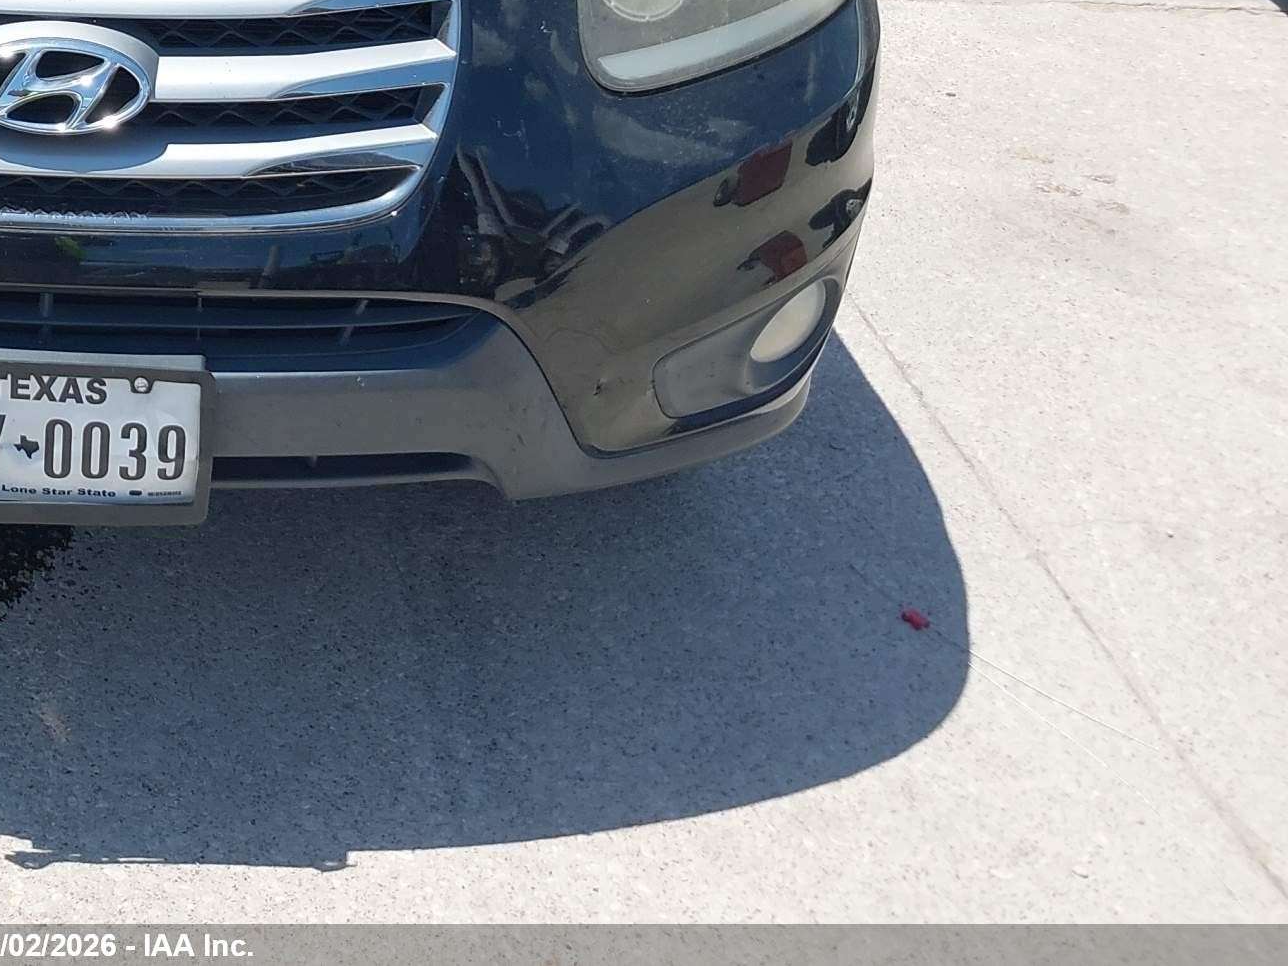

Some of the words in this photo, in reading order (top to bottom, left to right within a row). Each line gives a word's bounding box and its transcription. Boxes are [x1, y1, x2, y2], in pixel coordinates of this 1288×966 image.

[43, 418, 187, 481] 0039
[1, 484, 38, 495] Lone
[42, 487, 74, 497] Star
[78, 488, 117, 498] State
